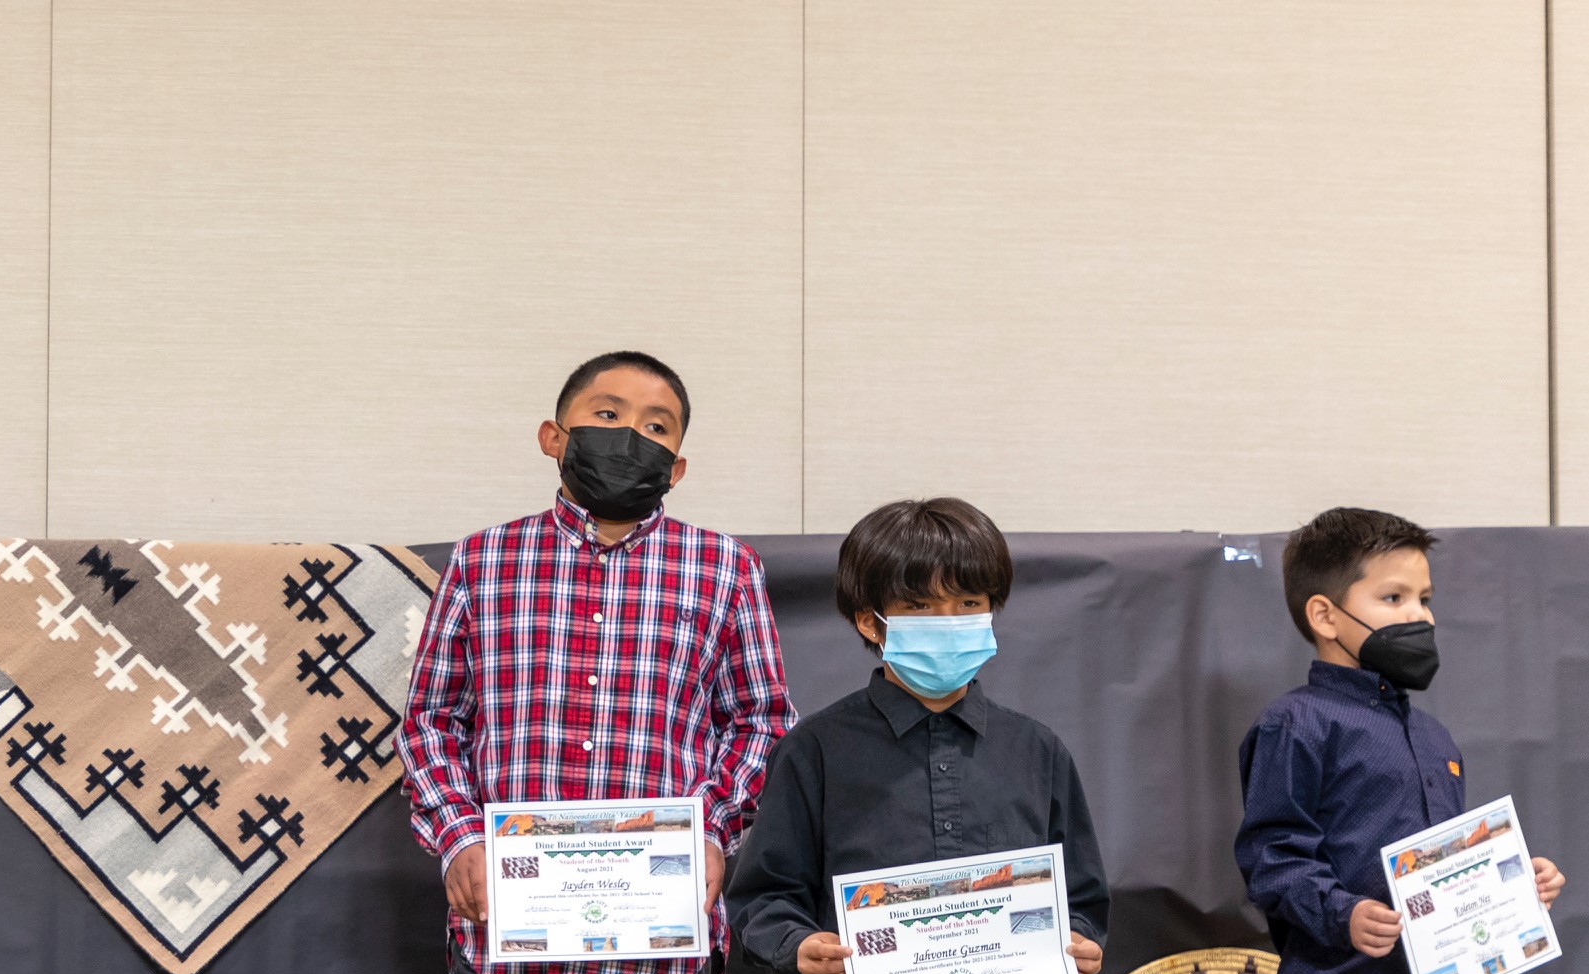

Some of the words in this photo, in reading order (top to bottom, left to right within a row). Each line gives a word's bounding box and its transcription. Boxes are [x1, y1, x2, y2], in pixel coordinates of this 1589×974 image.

[535, 842, 554, 850] Dine
[557, 841, 586, 849] Bizaad
[588, 840, 621, 848] Student
[625, 838, 653, 847] Award
[561, 879, 594, 892] Jayden
[597, 878, 631, 891] Wesley
[889, 911, 910, 920] Dine
[912, 904, 943, 916] Bizaad
[945, 900, 979, 911] Student
[983, 894, 1012, 905] Award
[916, 925, 943, 933] Student
[944, 922, 952, 930] of
[966, 917, 989, 926] Month
[928, 931, 962, 942] September
[964, 928, 979, 936] 2021
[913, 949, 957, 965] Jahvonte
[960, 942, 1001, 958] Guzman
